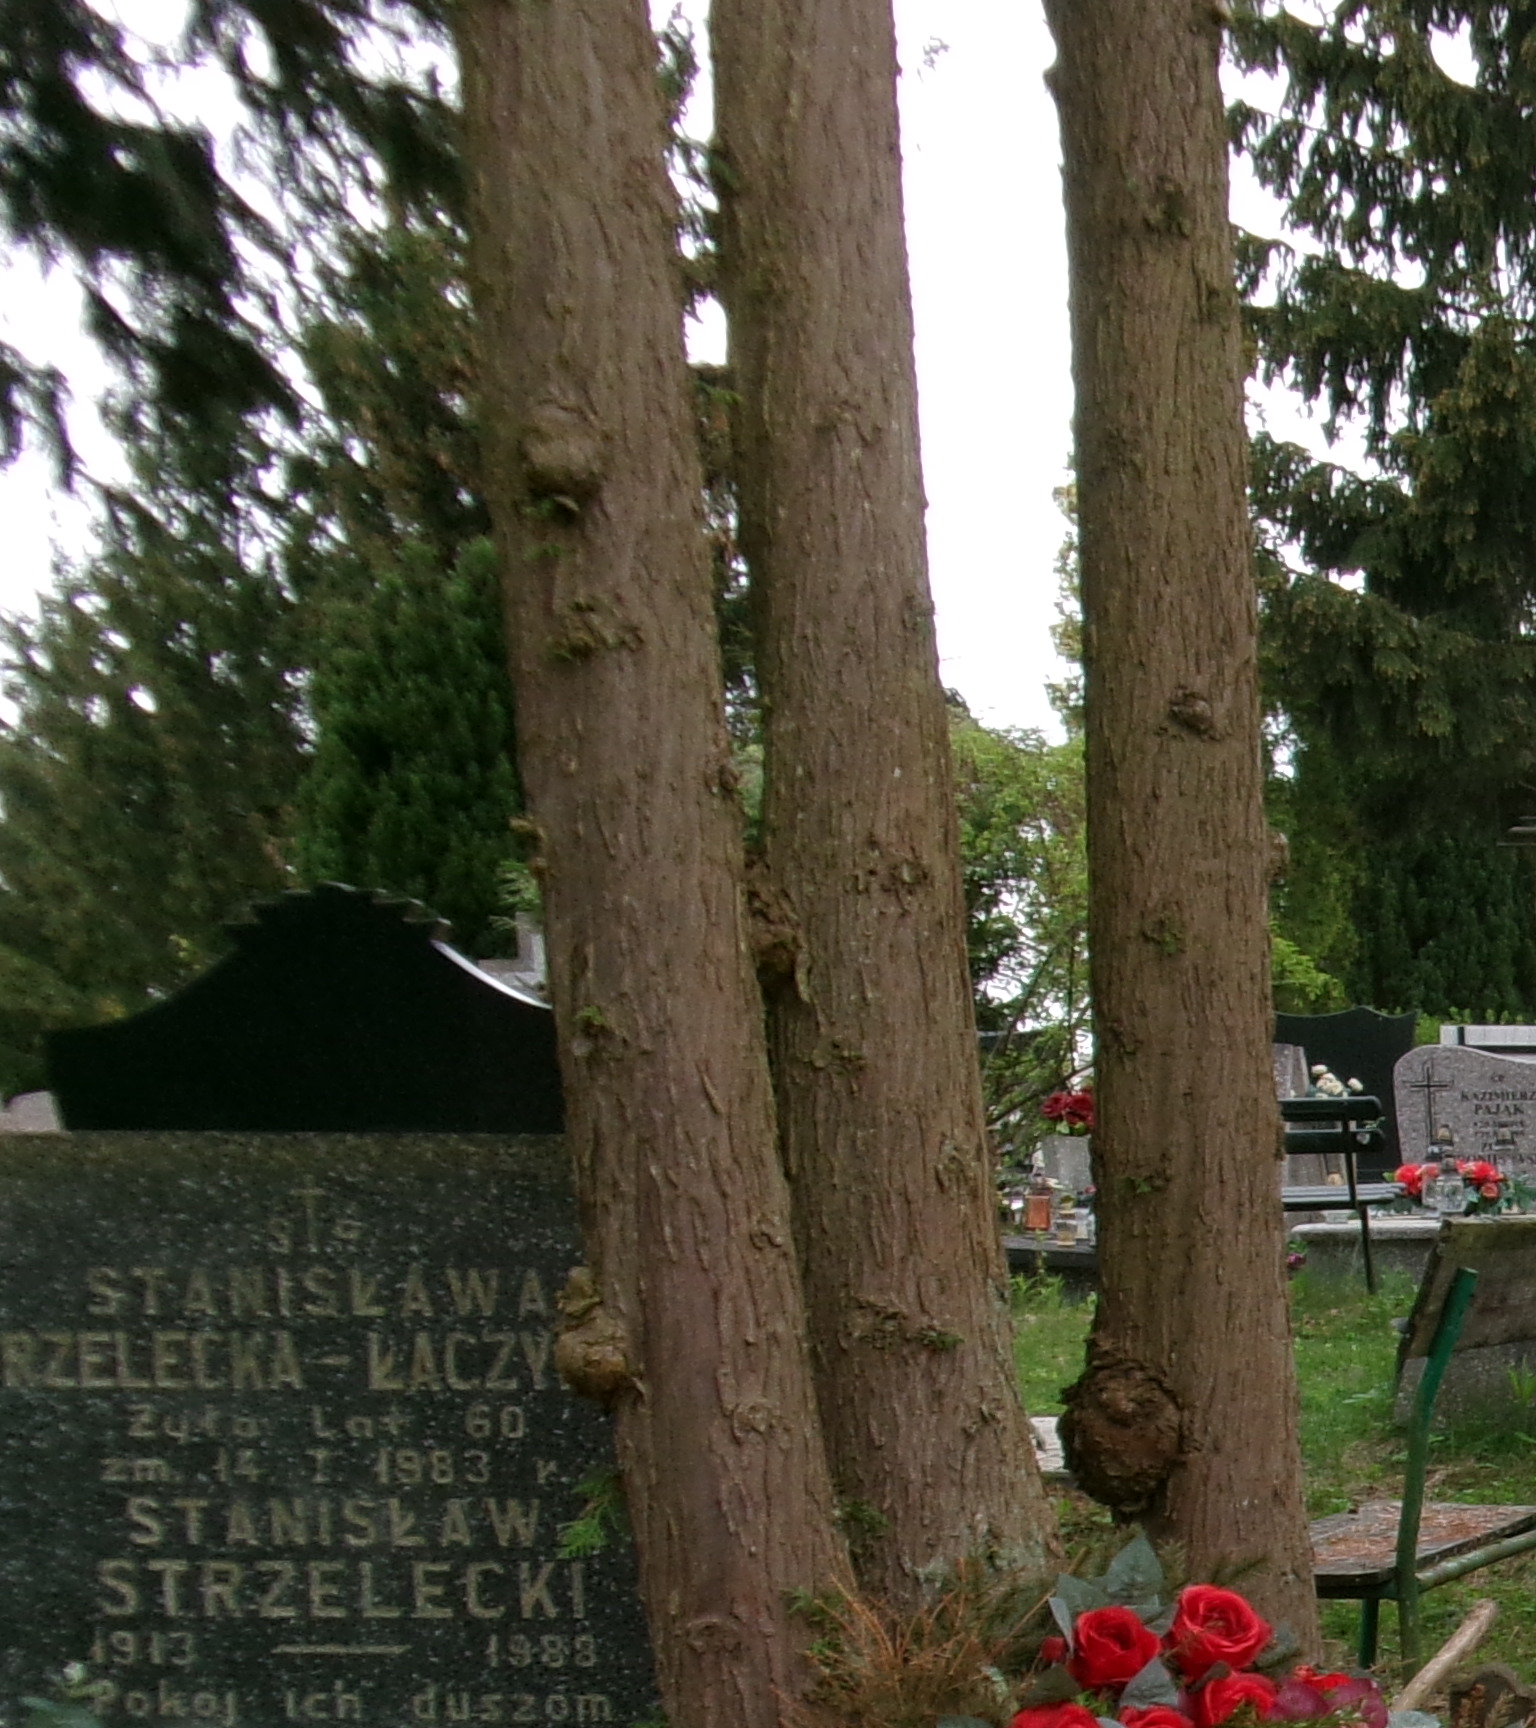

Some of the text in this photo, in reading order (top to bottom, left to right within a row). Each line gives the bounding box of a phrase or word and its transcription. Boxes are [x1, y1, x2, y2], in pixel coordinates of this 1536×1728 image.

[464, 1404, 526, 1439] 60
[374, 1448, 489, 1485] 1983
[125, 1498, 542, 1547] STANISŁAW
[101, 1559, 587, 1619] STRZELECKI
[92, 1630, 598, 1669] 1913 1988
[412, 1681, 616, 1723] duszom
